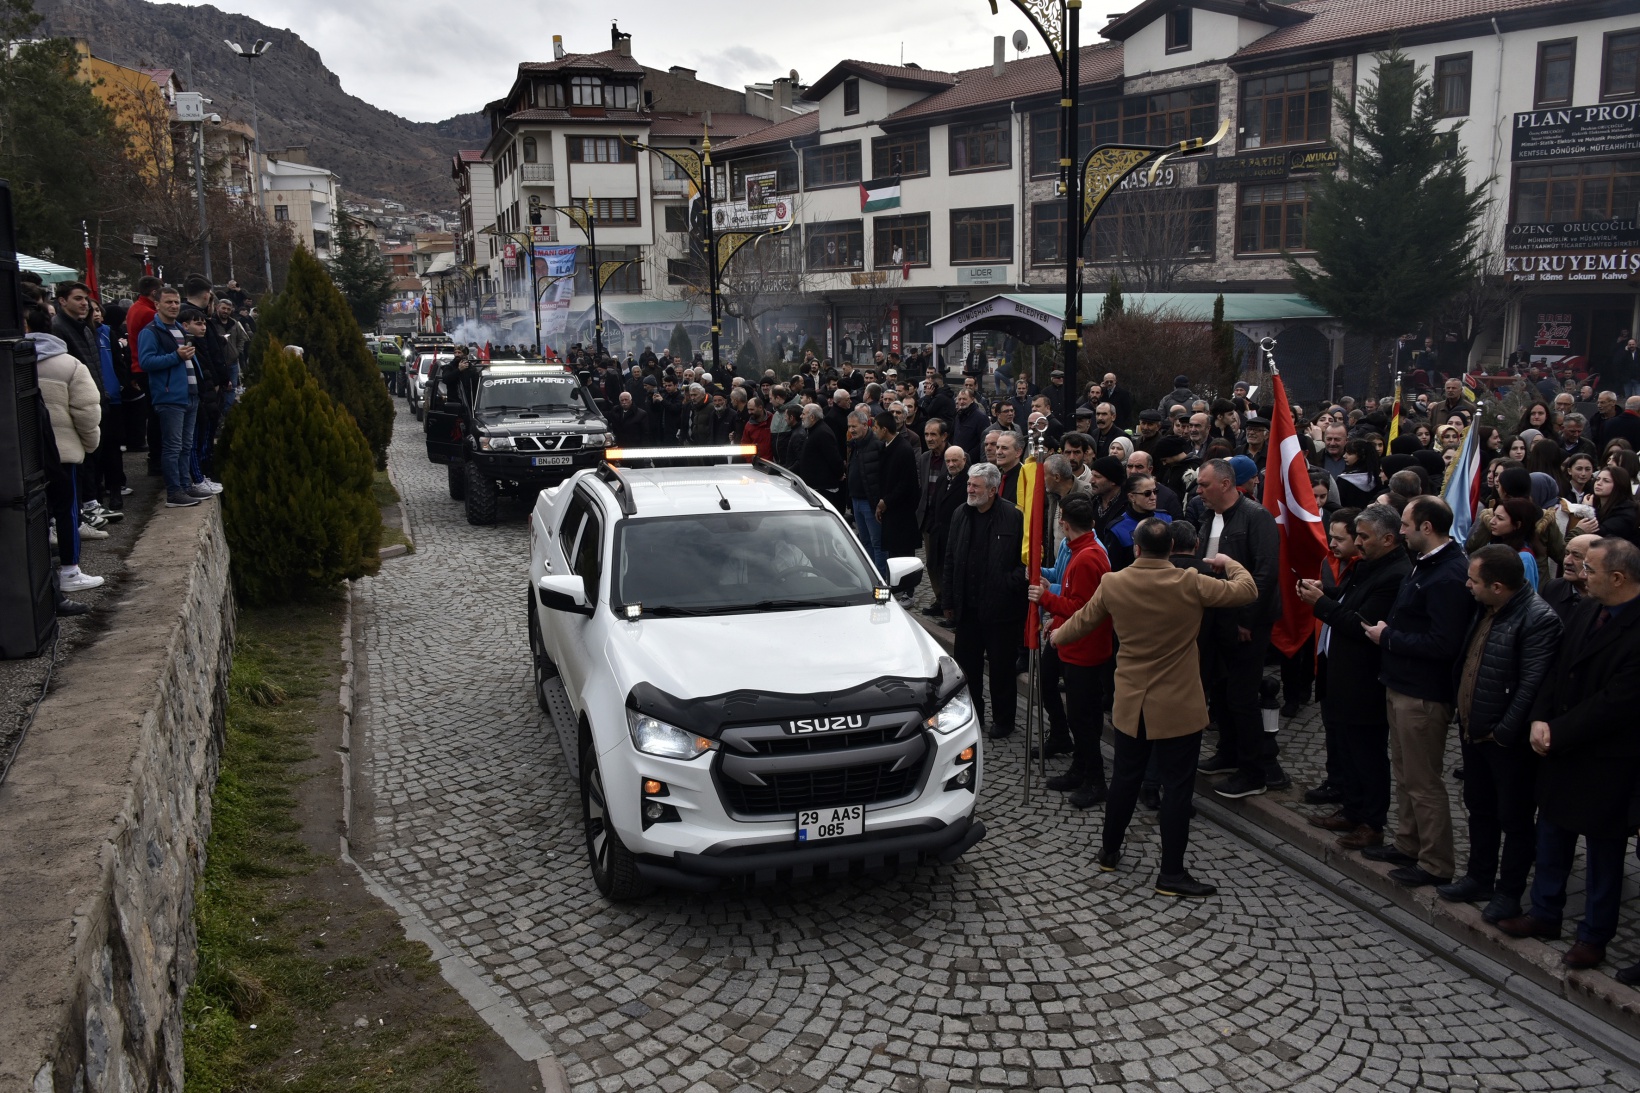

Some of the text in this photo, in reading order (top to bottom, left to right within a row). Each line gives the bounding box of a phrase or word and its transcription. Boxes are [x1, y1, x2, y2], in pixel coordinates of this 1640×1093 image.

[1517, 110, 1573, 129] PLAN
[1585, 103, 1640, 122] PROJ
[1304, 151, 1338, 163] AVUKAT
[1519, 149, 1548, 157] KENTSEL
[1155, 167, 1174, 186] 29
[1513, 224, 1555, 235] ÖZENÇ
[1505, 249, 1640, 275] KURUYEMİŞ
[1540, 272, 1563, 281] Köme
[1568, 272, 1597, 280] Lokum
[1601, 272, 1628, 280] Kahve
[957, 303, 1050, 324] GÜMÜŞHANE BELEDİYESİ
[493, 376, 565, 386] PATROL HYBRID
[538, 457, 548, 465] BN
[789, 714, 863, 734] ISUZU
[801, 807, 861, 826] 29 AAS
[818, 822, 845, 837] 085
